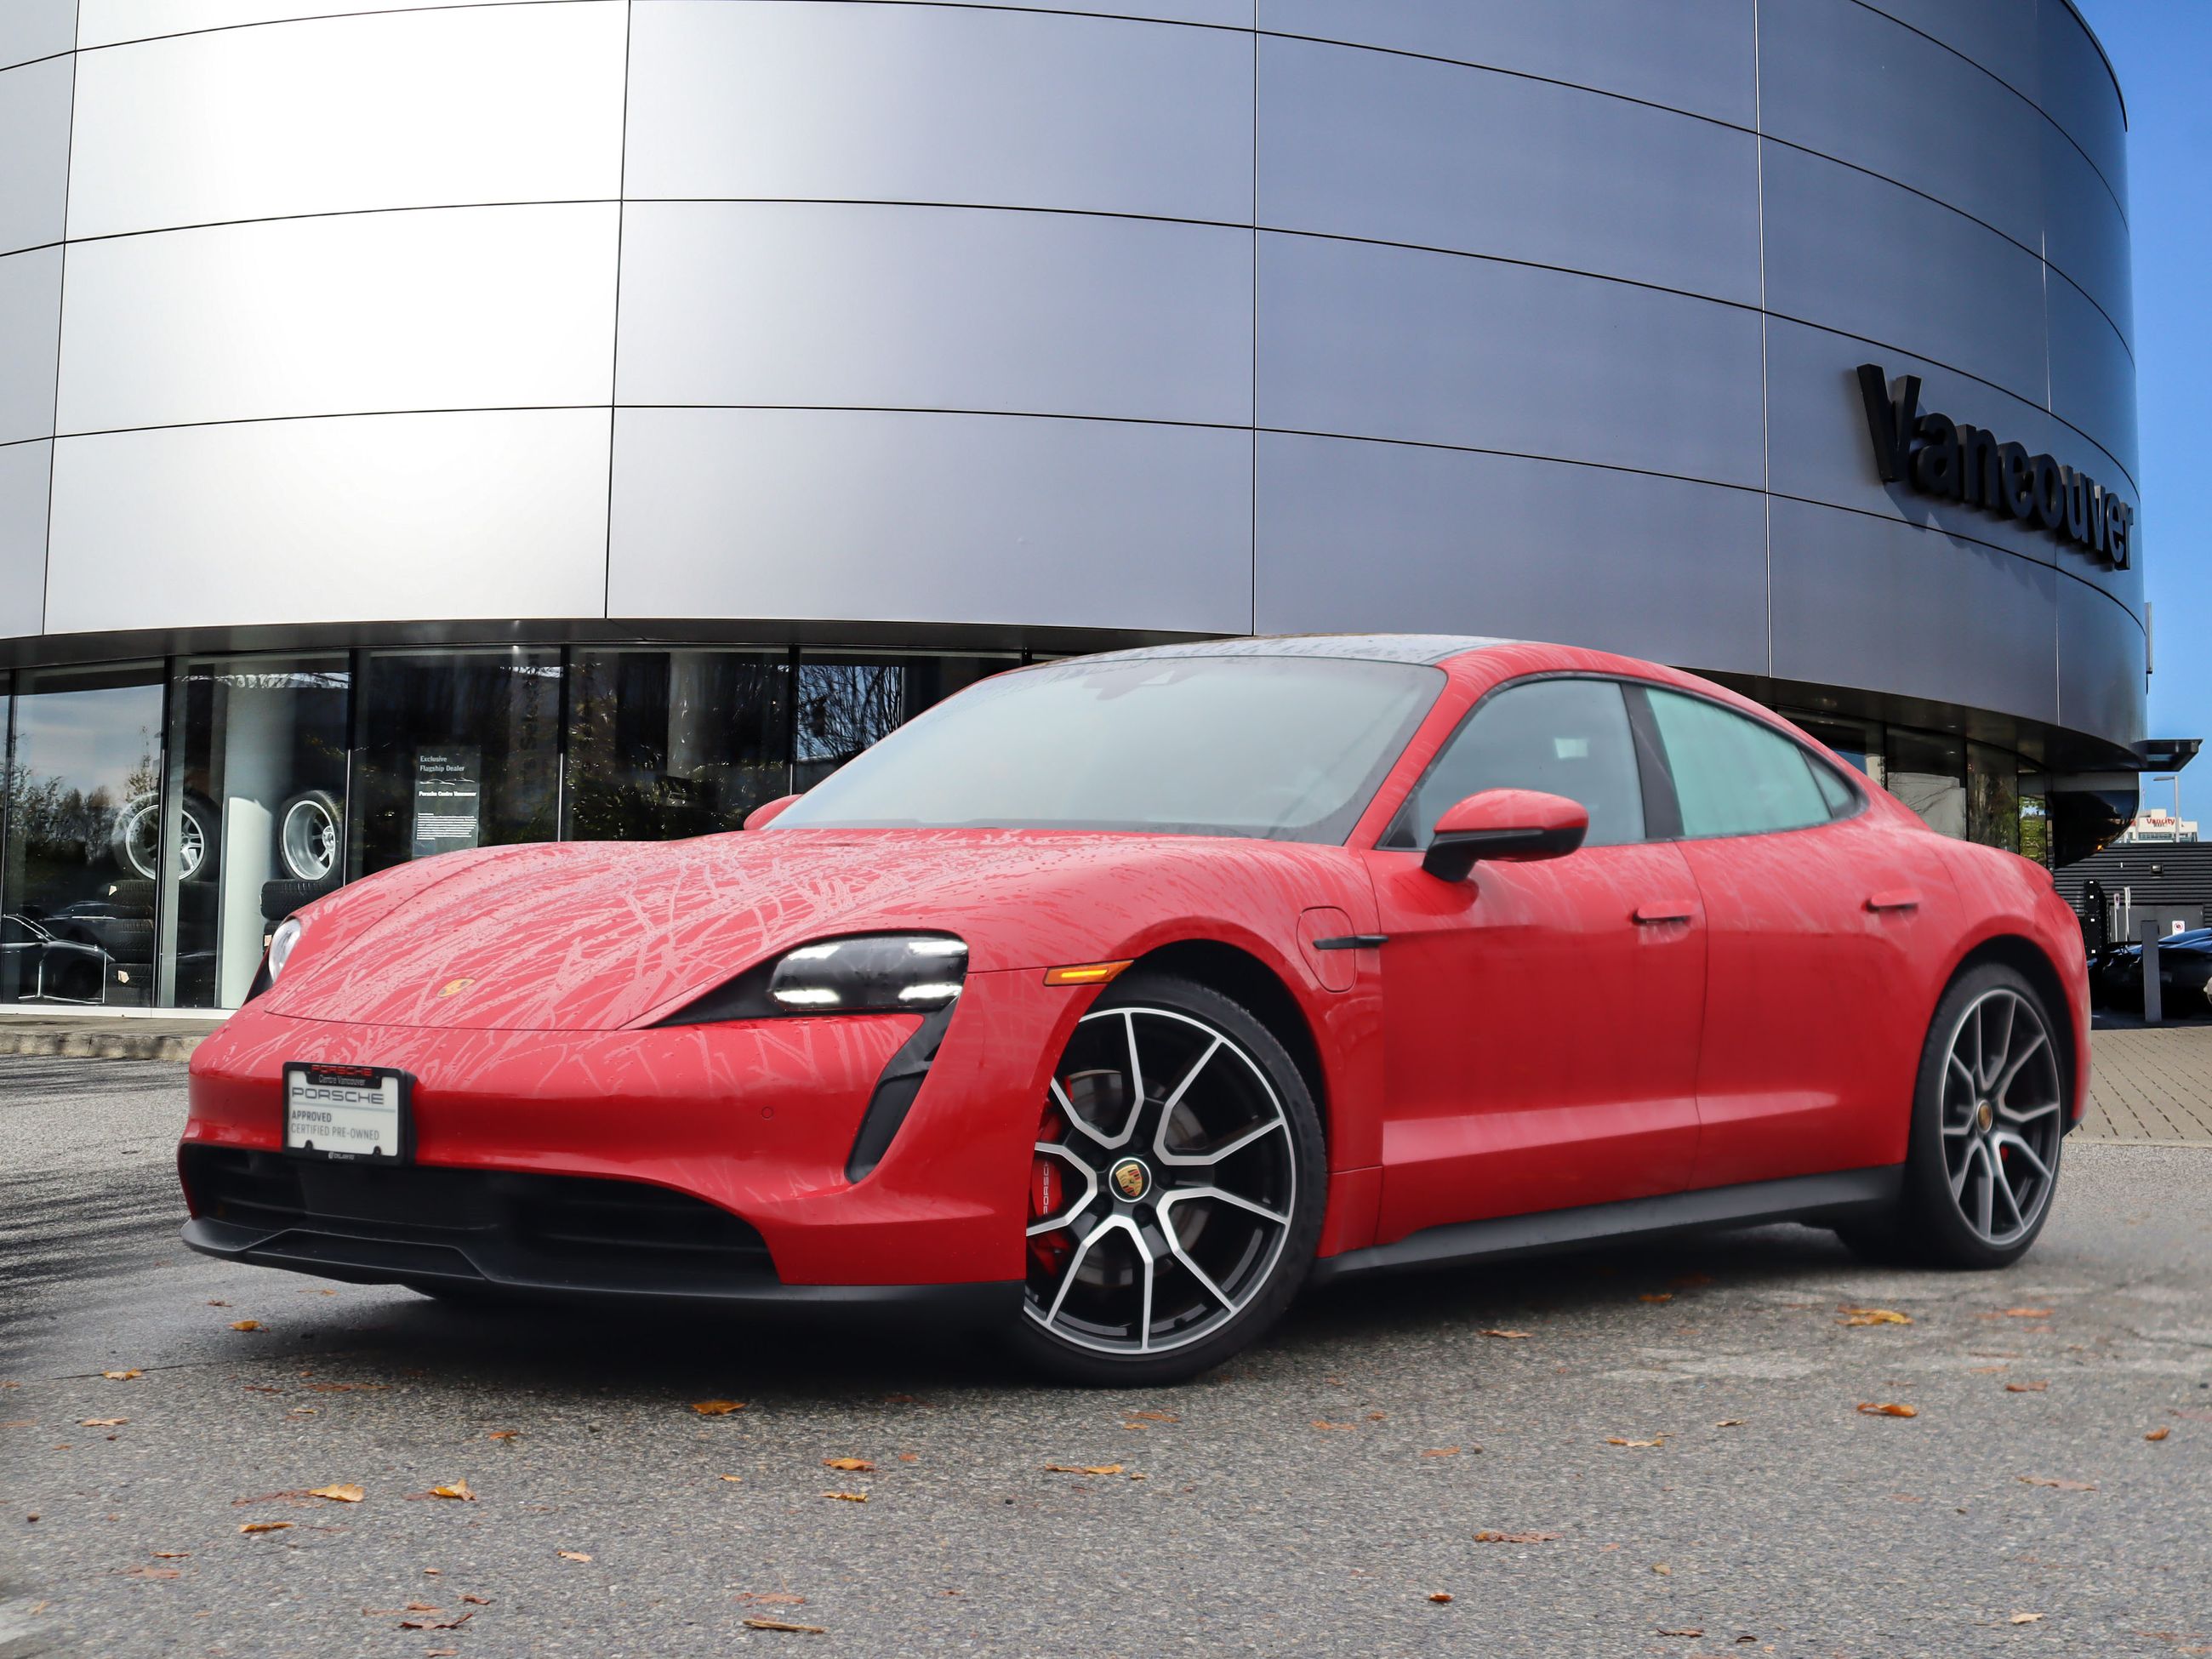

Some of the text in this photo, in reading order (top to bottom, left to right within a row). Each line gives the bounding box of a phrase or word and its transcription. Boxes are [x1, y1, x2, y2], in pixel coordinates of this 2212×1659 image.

[1856, 363, 2134, 570] Vancouver
[292, 1087, 385, 1105] PORSCHE
[291, 1109, 332, 1123] APPROVED
[291, 1123, 379, 1142] CERTIFIED PRE-OWNED
